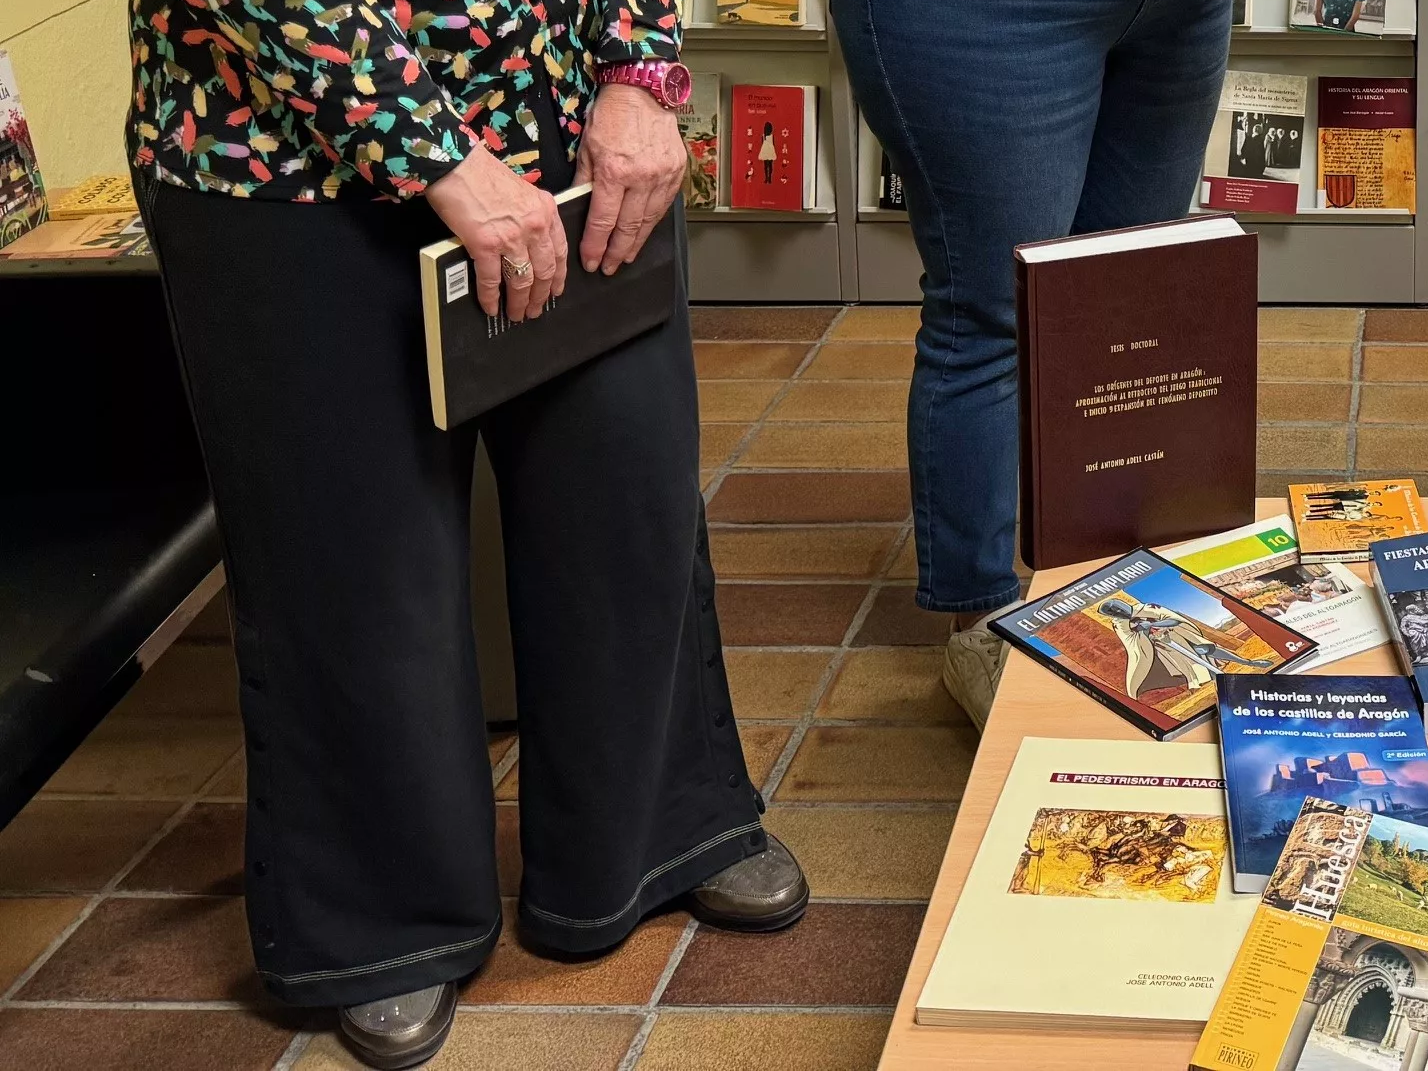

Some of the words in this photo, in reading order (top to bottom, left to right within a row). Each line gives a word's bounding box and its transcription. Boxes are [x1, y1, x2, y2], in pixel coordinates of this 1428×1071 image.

[1110, 344, 1125, 353] TESIS
[1131, 339, 1159, 350] DOCTORAL
[1094, 384, 1105, 393] LOS
[1106, 380, 1133, 392] ORÍGENES
[1134, 378, 1144, 387] DEL
[1145, 374, 1169, 385] DEPORTE
[1171, 372, 1178, 380] EN
[1267, 535, 1289, 547] 10
[1017, 616, 1038, 633] EL
[1034, 593, 1087, 624] ÚLTIMO
[1082, 560, 1153, 601] TEMPLARIO
[1250, 689, 1312, 703] Historias
[1315, 693, 1324, 704] y
[1327, 691, 1387, 705] leyendas
[1233, 706, 1250, 716] de
[1255, 707, 1275, 717] los
[1278, 707, 1333, 719] castillos
[1336, 709, 1355, 719] de
[1358, 707, 1409, 720] Aragón
[1263, 729, 1300, 737] ANTONIO
[1378, 729, 1407, 738] GARCÍA
[1056, 774, 1071, 783] EL
[1073, 774, 1160, 786] PEDESTRISMO
[1163, 777, 1179, 787] EN
[1292, 816, 1371, 922] Huesca
[1137, 973, 1182, 982] CELEDONIO
[1217, 1049, 1254, 1070] PIRINEO
